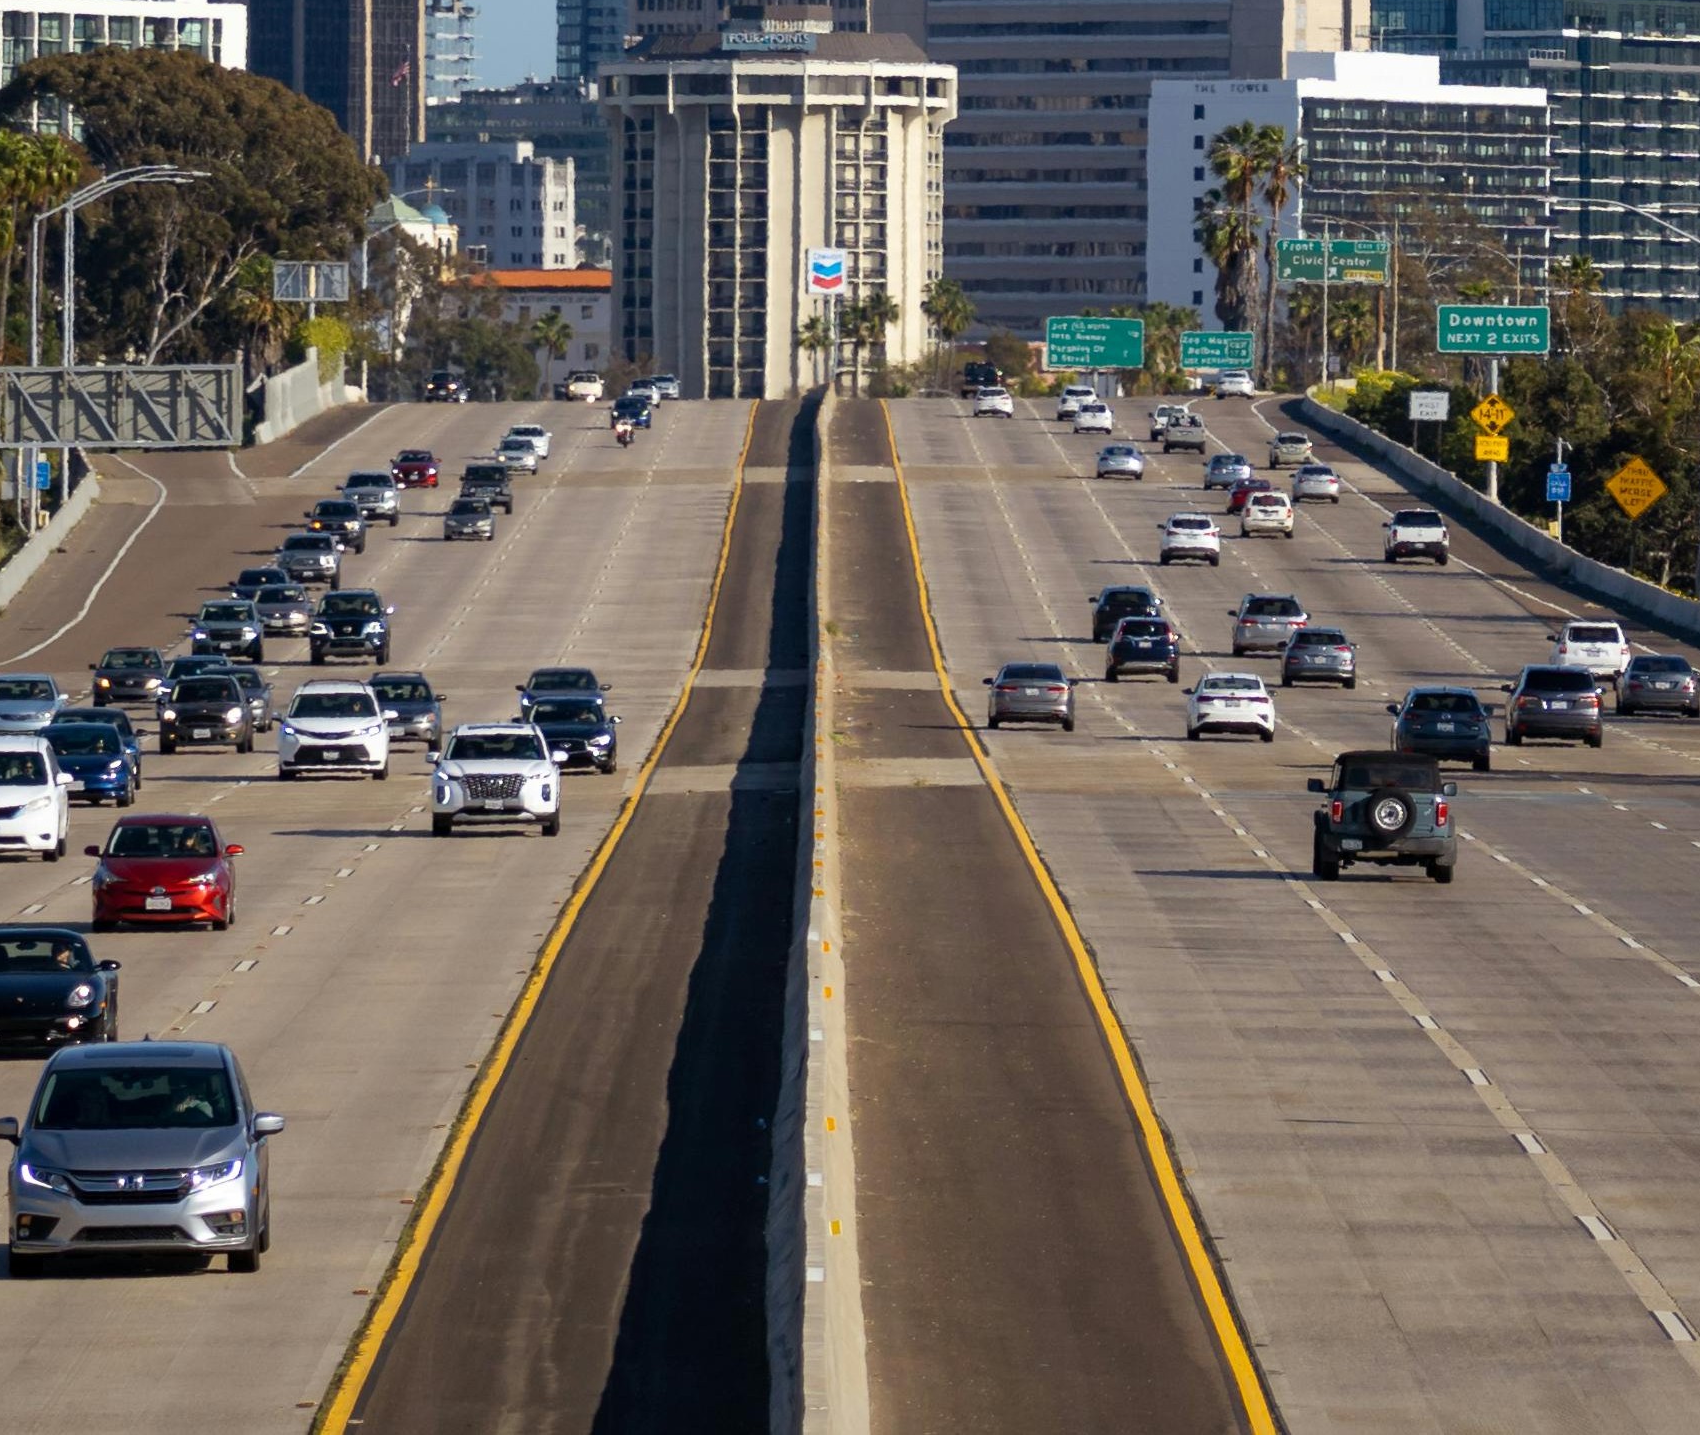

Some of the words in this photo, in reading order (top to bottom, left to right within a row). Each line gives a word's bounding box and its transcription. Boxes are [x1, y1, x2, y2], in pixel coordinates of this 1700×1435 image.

[770, 33, 811, 44] POINTS
[1282, 241, 1314, 252] Front
[1292, 255, 1324, 265] Civic
[1332, 256, 1371, 267] Center
[1450, 313, 1538, 327] Downtown
[1447, 333, 1481, 343] NEXT
[1486, 332, 1497, 345] 2
[1502, 333, 1540, 344] EXITS
